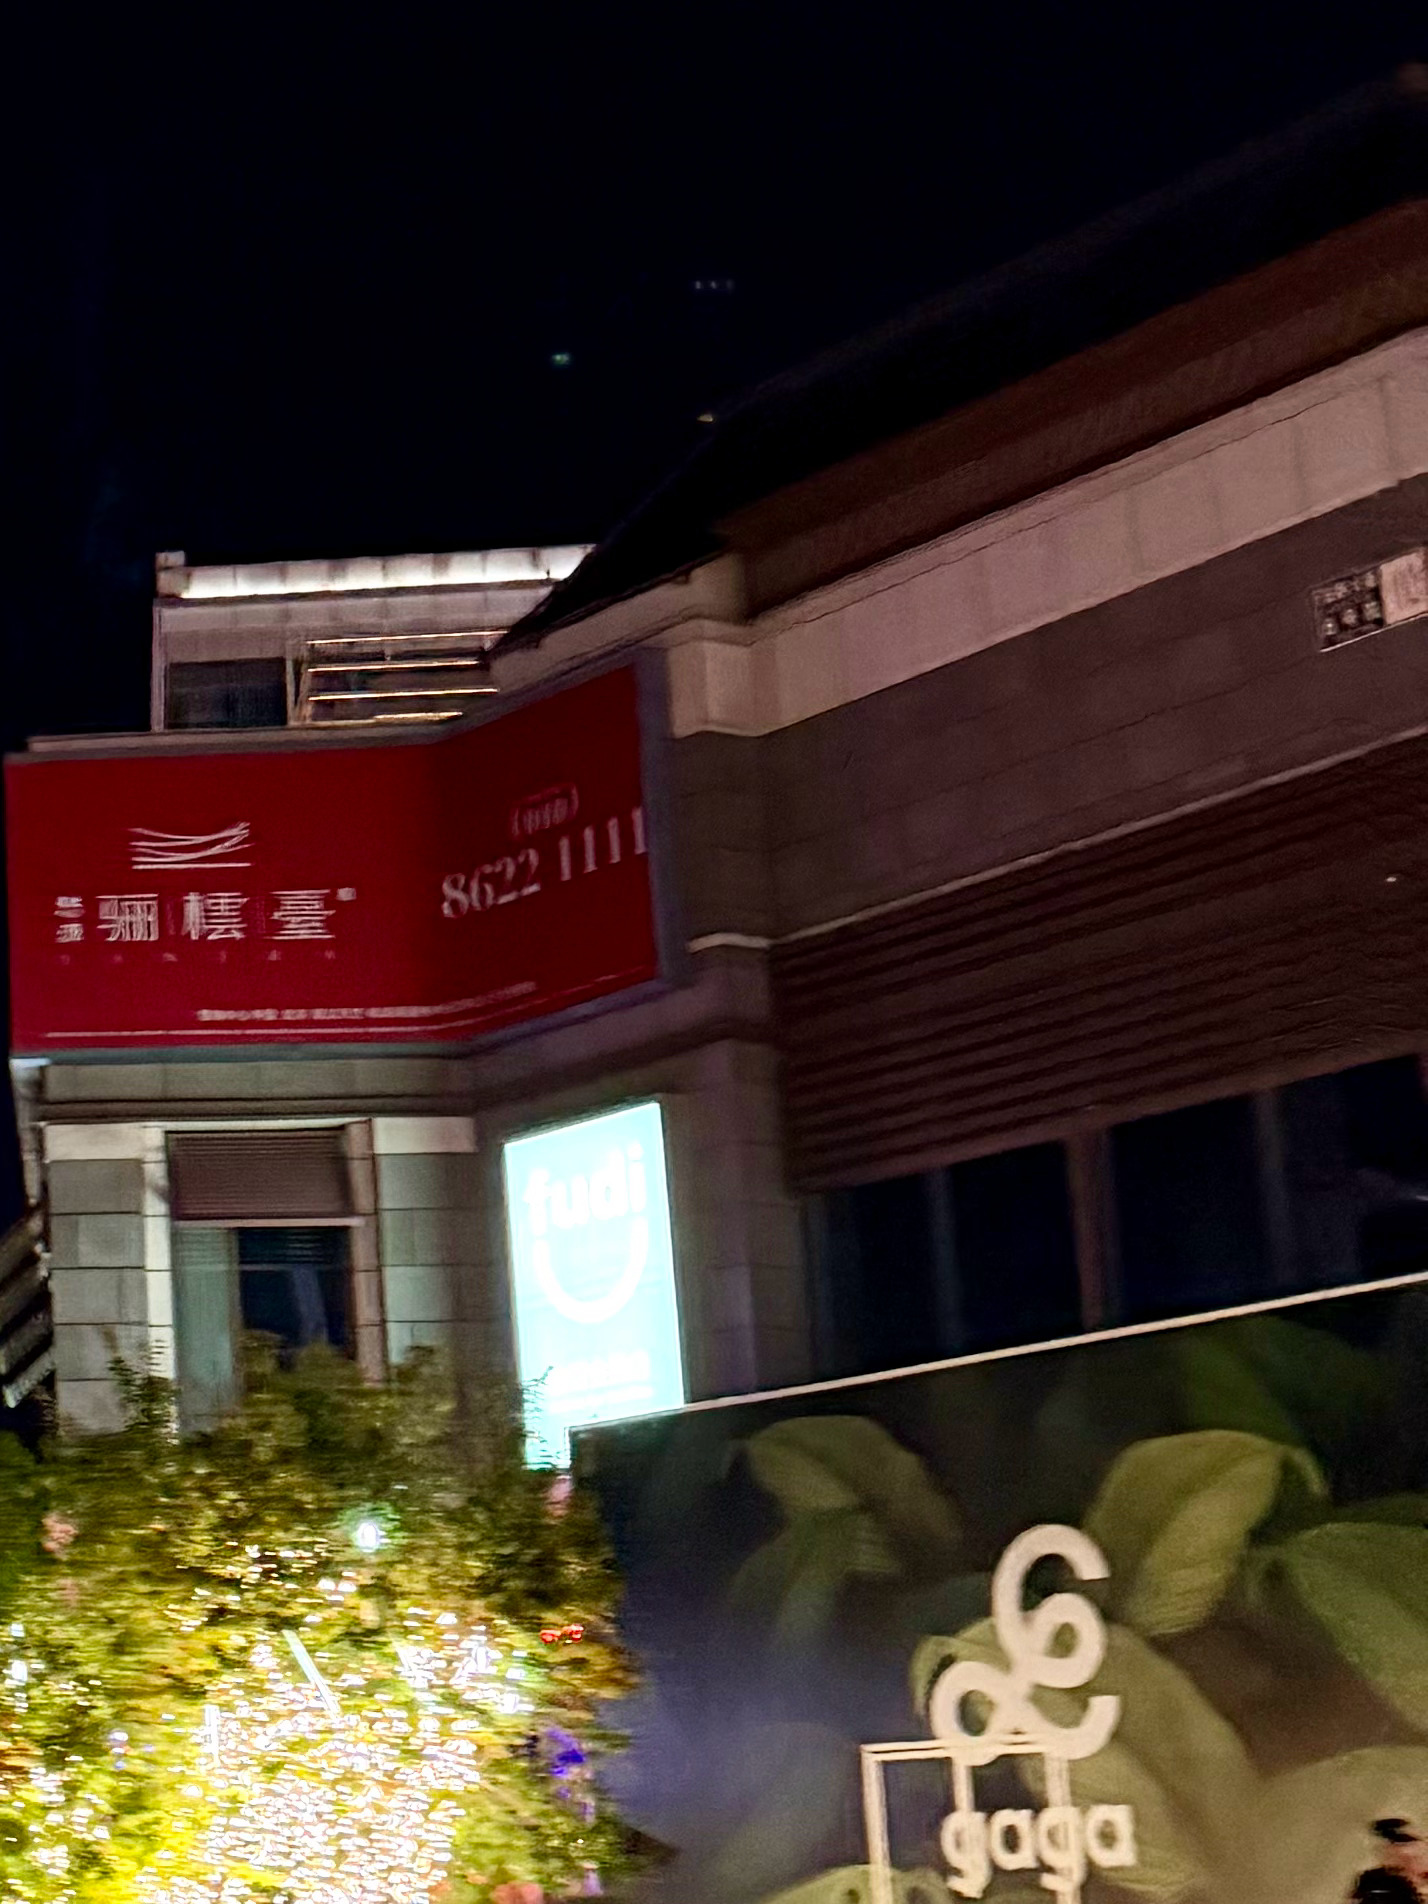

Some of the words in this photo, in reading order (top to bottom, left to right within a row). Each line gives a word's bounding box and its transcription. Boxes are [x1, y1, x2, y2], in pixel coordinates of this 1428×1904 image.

[441, 848, 541, 919] 8622
[558, 806, 647, 881] 1111
[523, 1140, 647, 1237] fudi
[940, 1804, 1138, 1899] gaga
